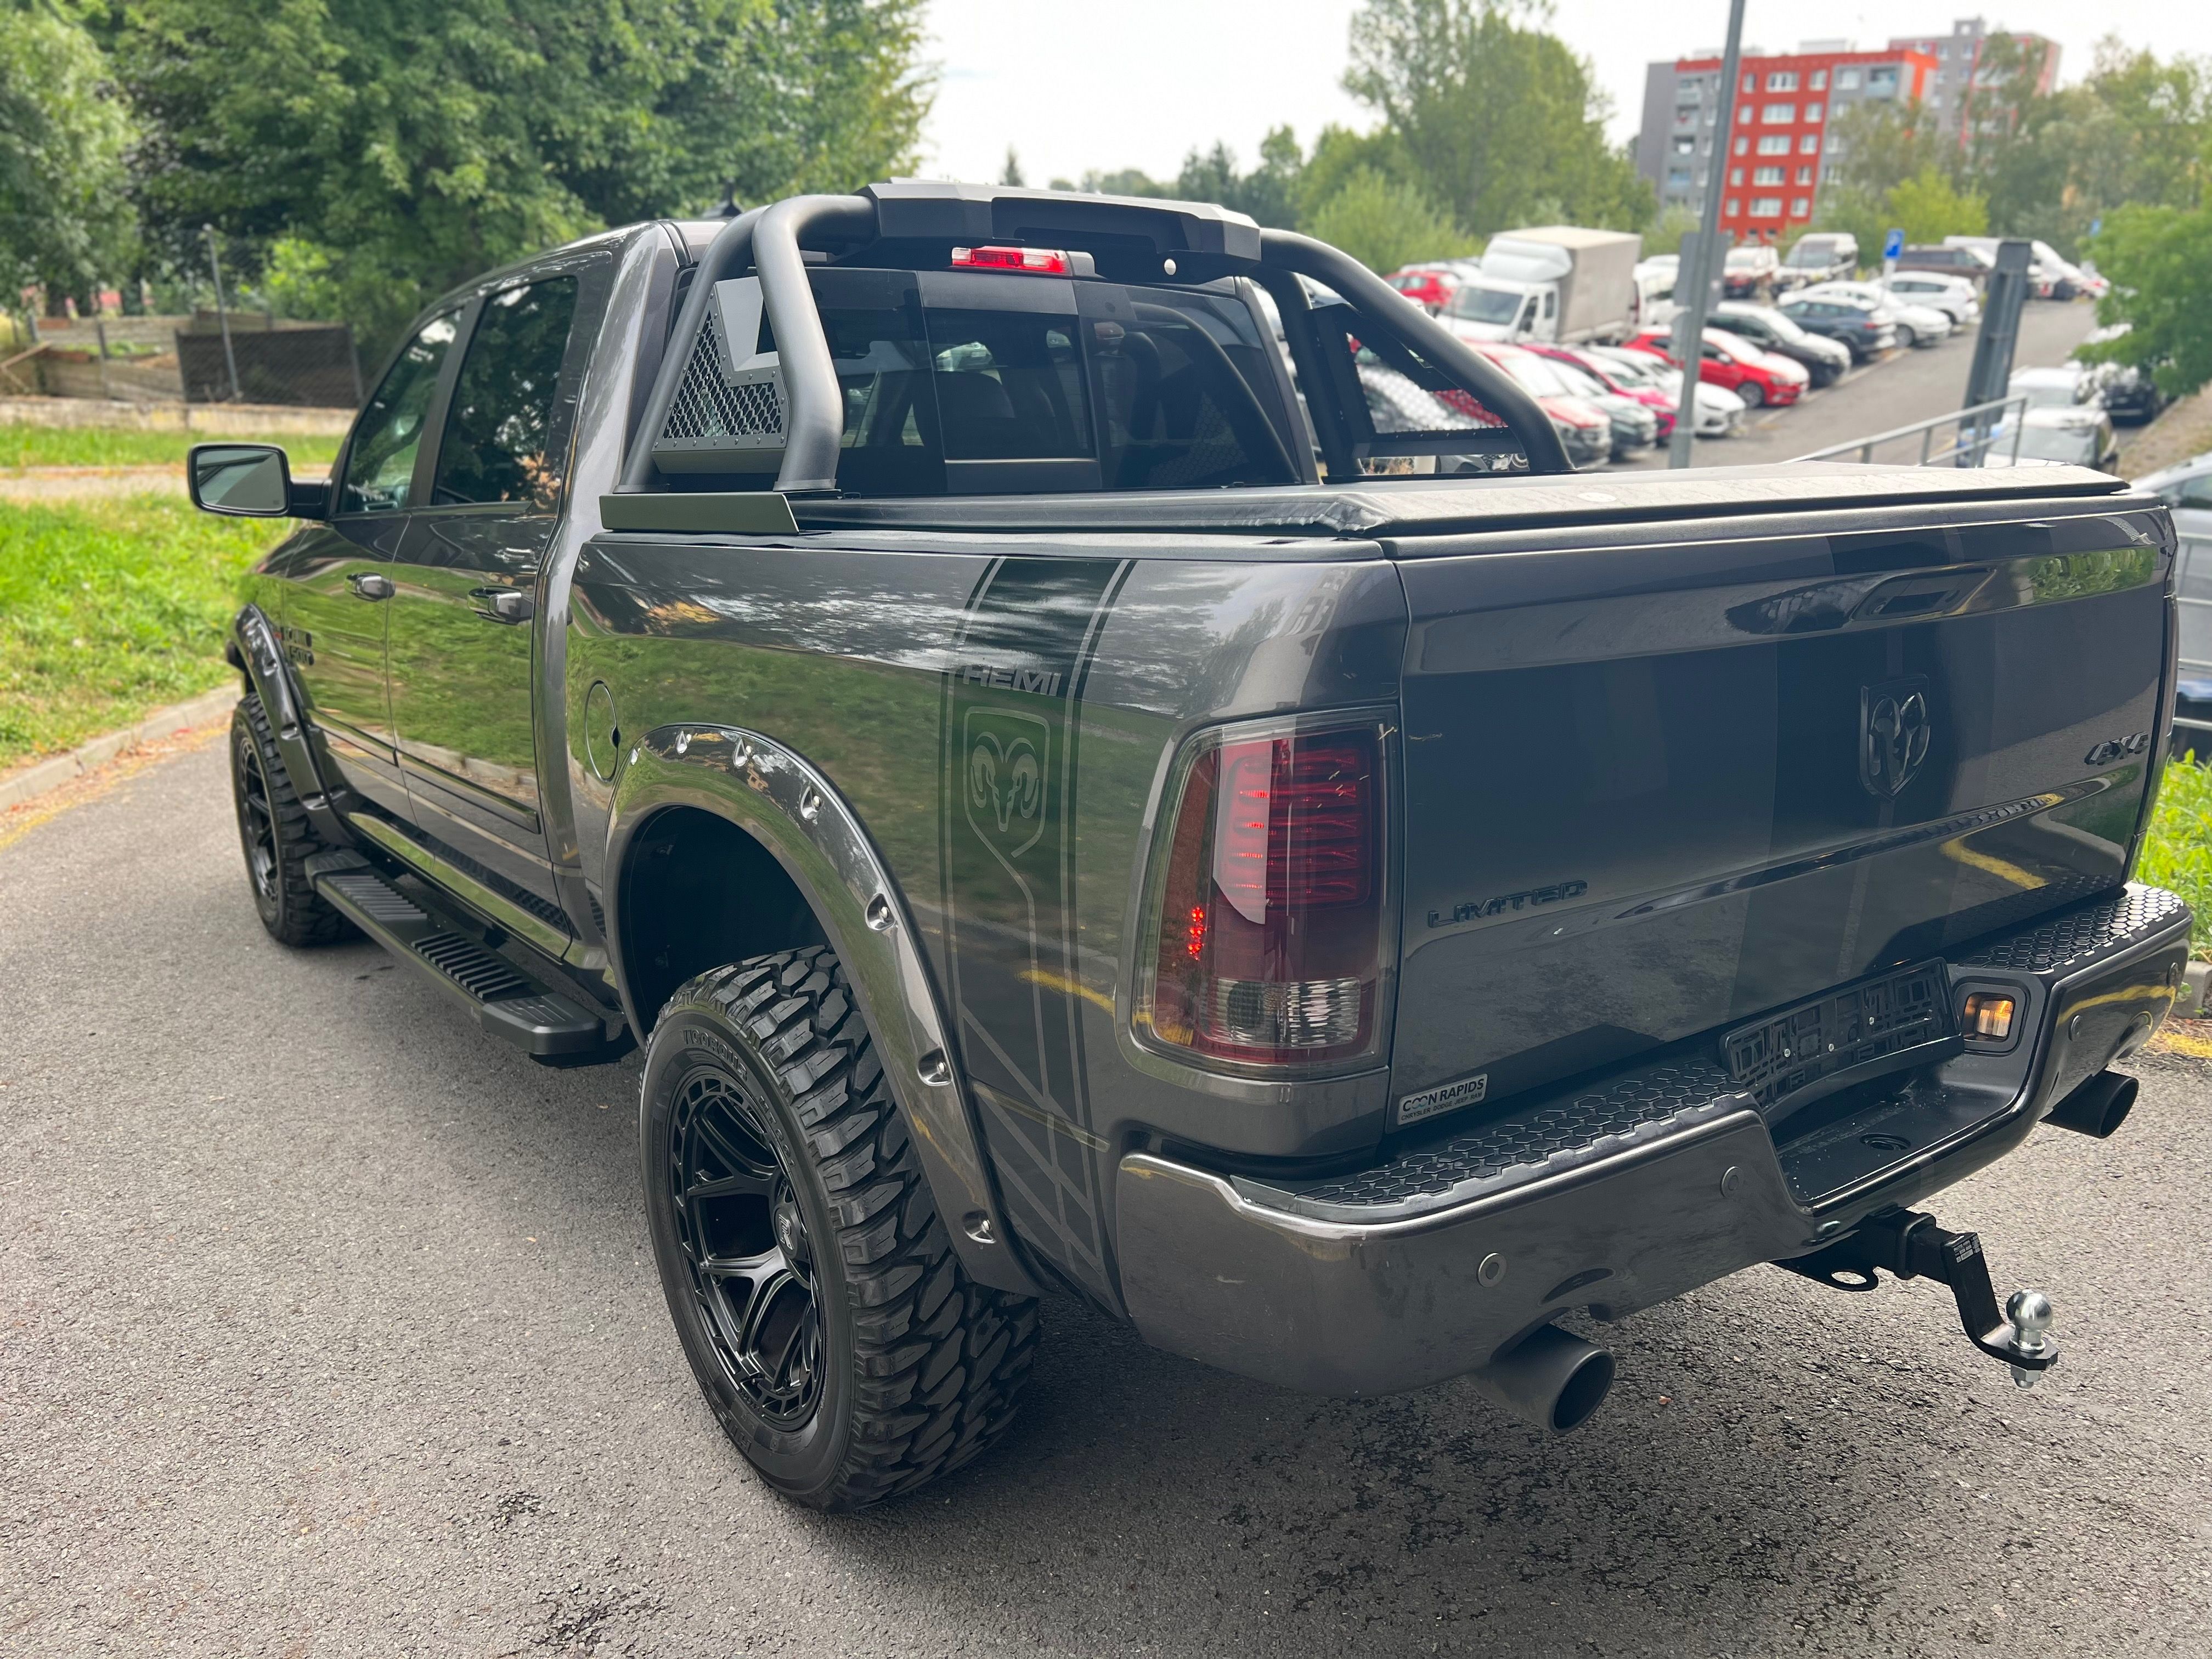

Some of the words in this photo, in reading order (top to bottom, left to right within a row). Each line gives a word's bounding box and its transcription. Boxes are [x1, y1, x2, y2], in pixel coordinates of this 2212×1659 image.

[963, 664, 1062, 697] HEMI
[1428, 879, 1588, 928] LIMITED
[1401, 1107, 1431, 1121] CHRYSLER
[1433, 1101, 1452, 1111] DODGE
[1454, 1097, 1468, 1105] JEEP
[1403, 1092, 1437, 1112] COON
[1440, 1079, 1484, 1101] RAPIDS
